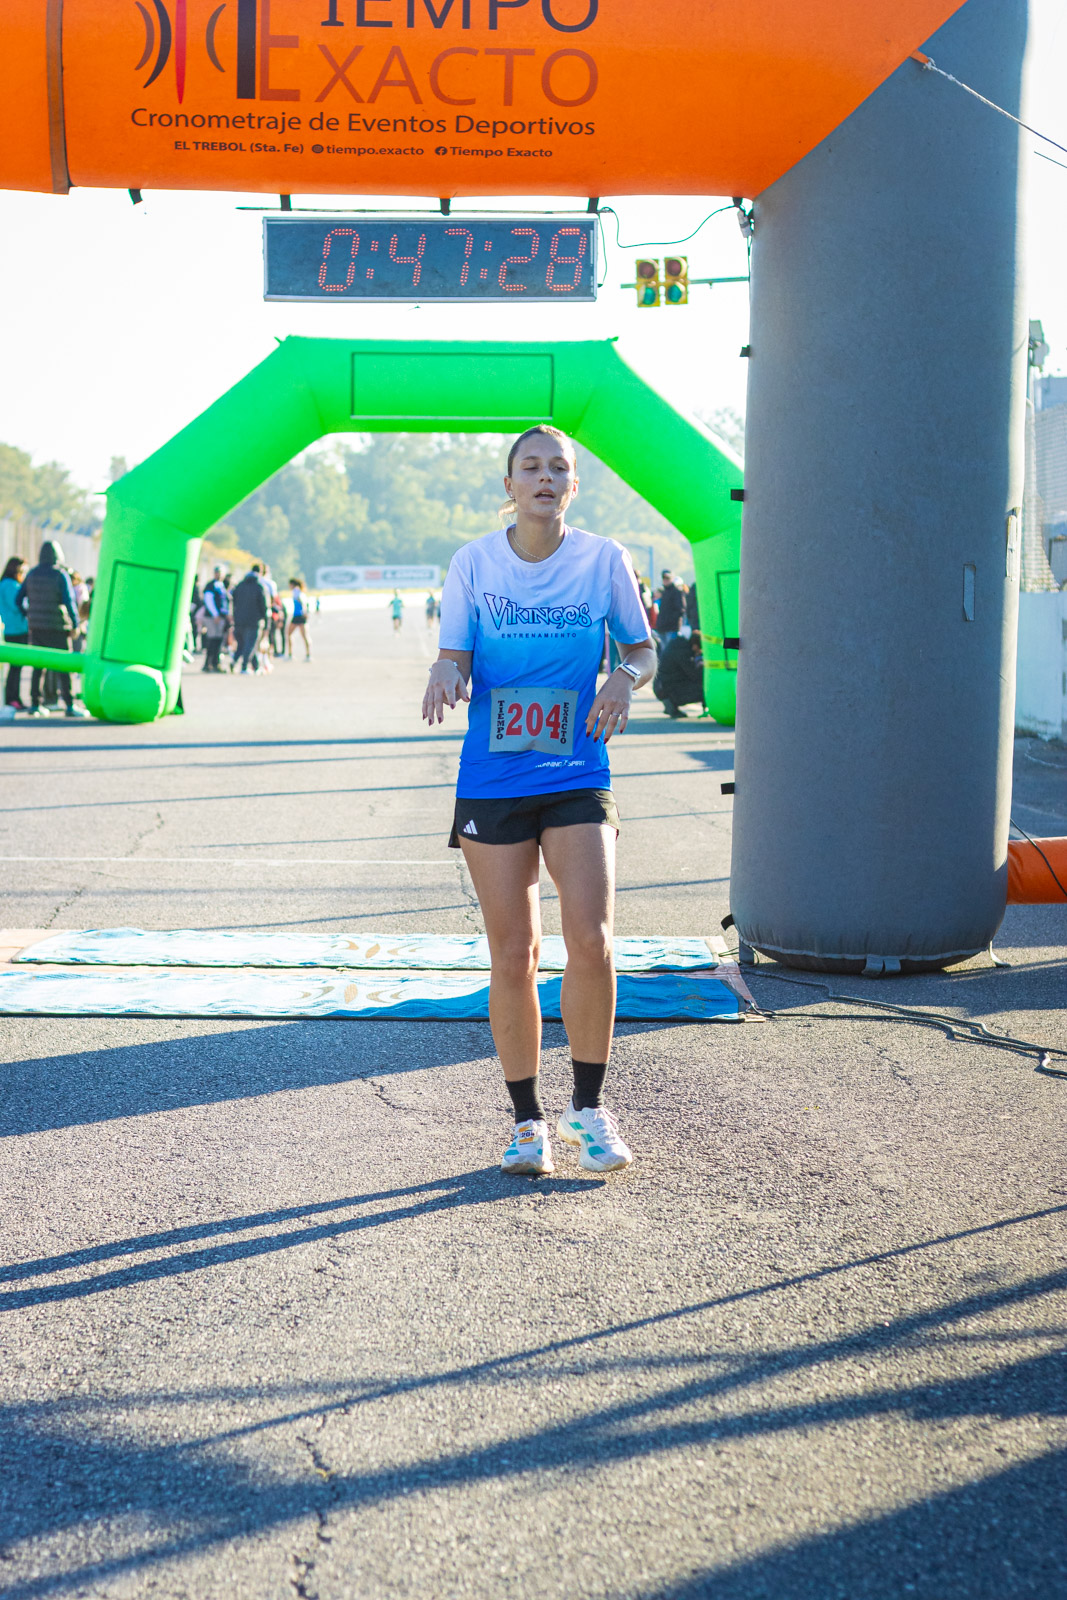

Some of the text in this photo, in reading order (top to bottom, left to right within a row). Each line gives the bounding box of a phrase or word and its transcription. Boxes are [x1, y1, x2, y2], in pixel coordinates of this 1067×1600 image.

[259, 0, 599, 107] EXACTO
[131, 108, 595, 138] Cronometraje de Eventos Deportivos
[174, 141, 553, 158] EL TREBOL (Sta. Fe) tiempo.exacto Tiempo Exacto
[318, 228, 587, 292] 0:47:28
[496, 700, 505, 740] TIEMPO
[505, 702, 561, 739] 204
[560, 702, 569, 744] EXACTO
